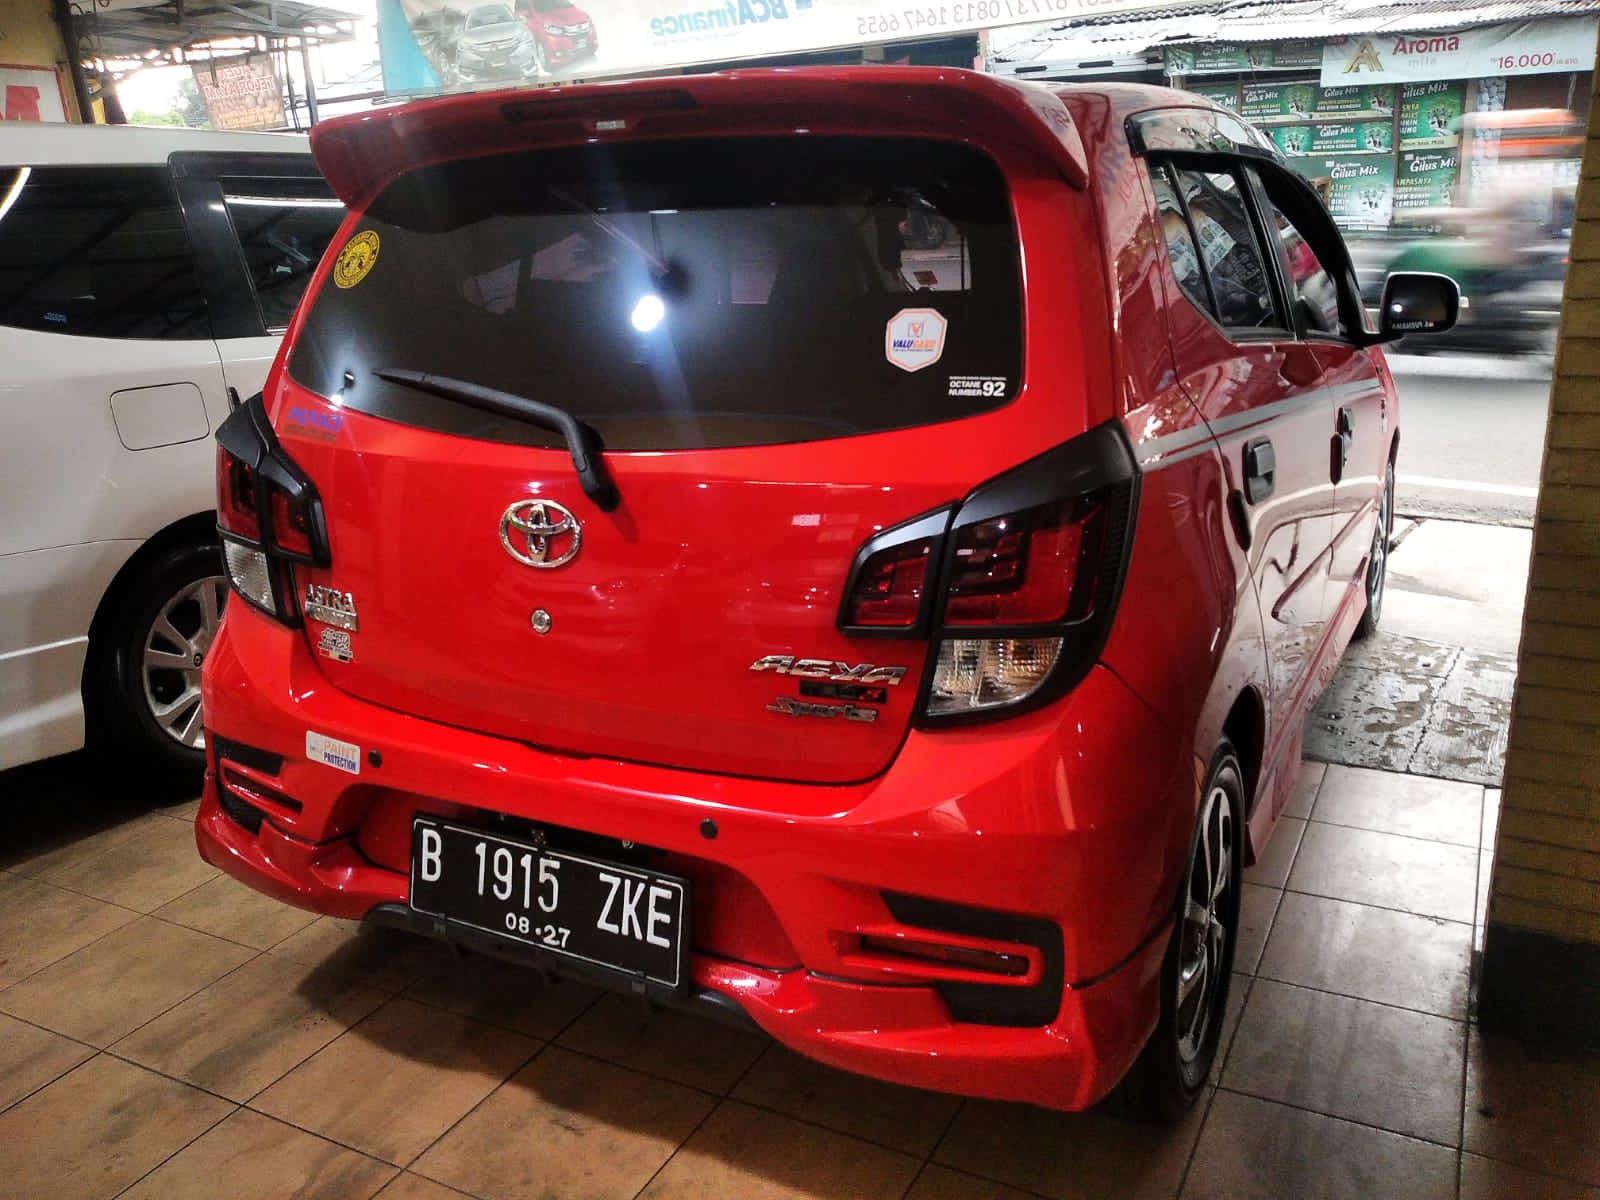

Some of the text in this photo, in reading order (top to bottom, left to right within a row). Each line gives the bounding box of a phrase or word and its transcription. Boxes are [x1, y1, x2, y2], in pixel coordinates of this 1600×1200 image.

[1392, 35, 1460, 56] Aroma
[1498, 52, 1554, 69] 16.000
[1428, 82, 1449, 95] Mix
[1331, 167, 1357, 179] Gilus
[1359, 164, 1379, 176] Mix
[1410, 157, 1457, 173] Gilus Mi
[949, 380, 981, 389] OCTANE
[949, 388, 982, 396] NUMBER
[982, 381, 1006, 397] 92
[749, 655, 907, 685] AGYA
[323, 751, 356, 772] PROTECTION
[421, 828, 673, 949] B 1915 ZKE
